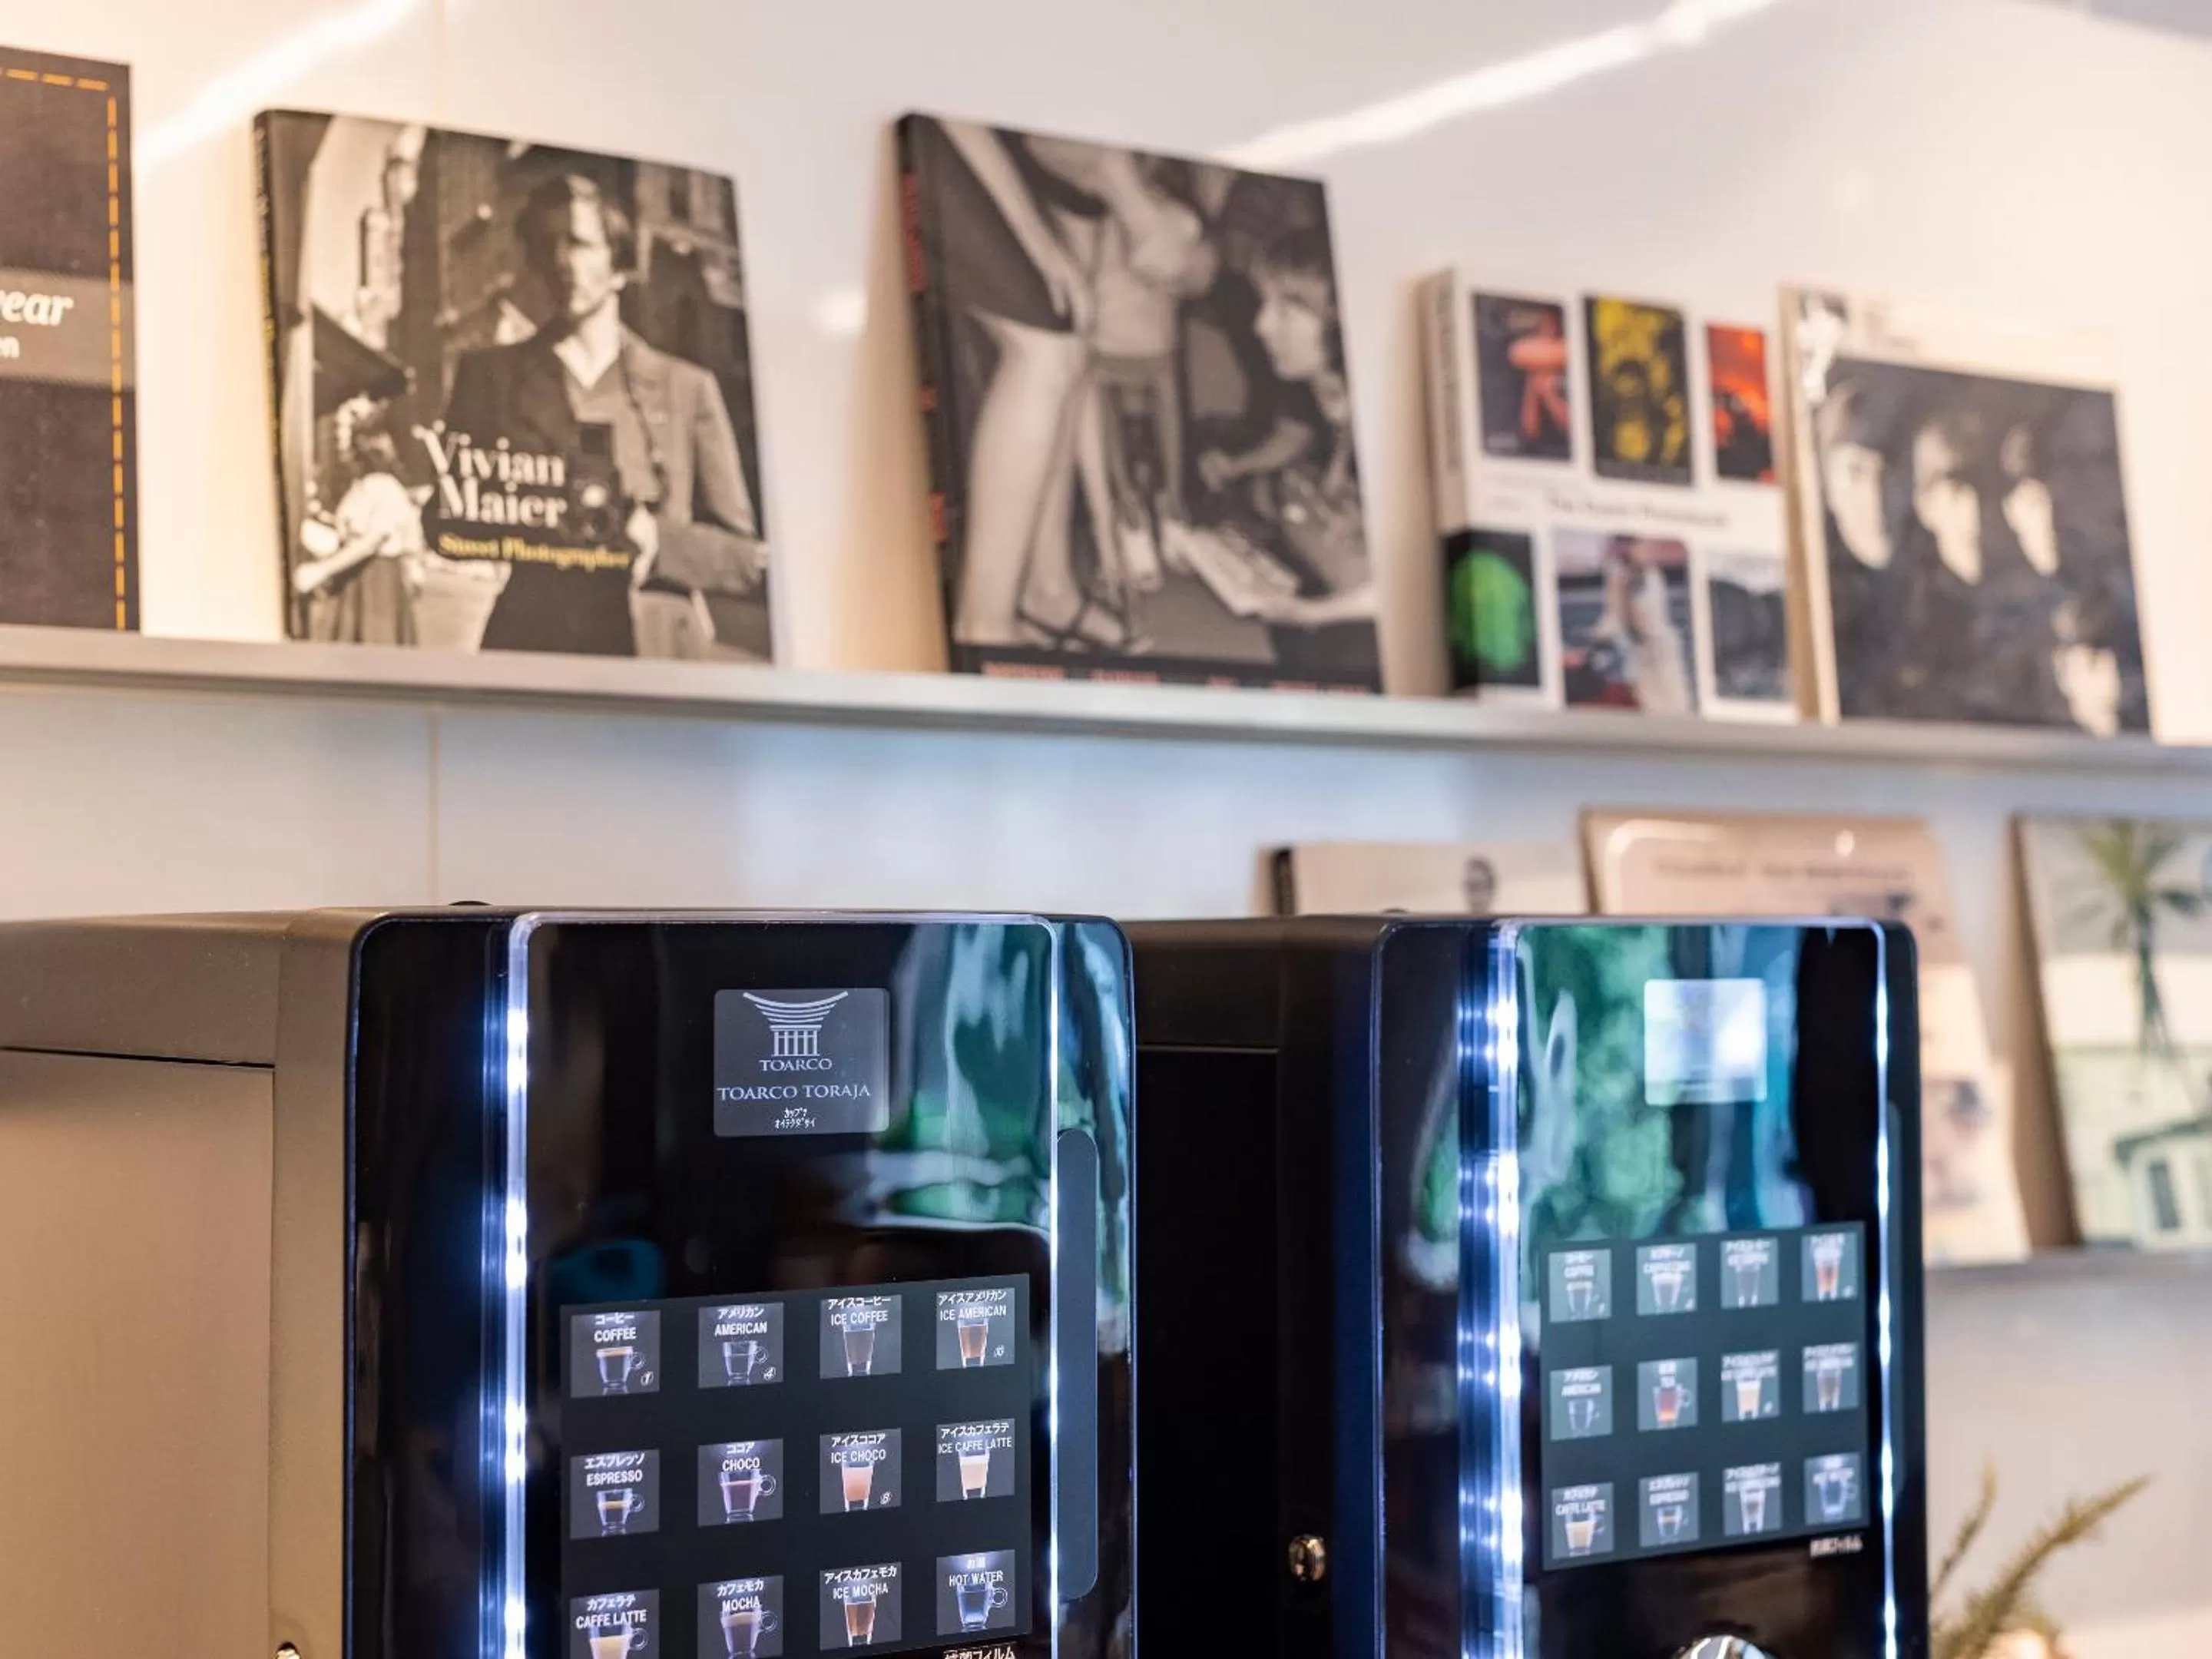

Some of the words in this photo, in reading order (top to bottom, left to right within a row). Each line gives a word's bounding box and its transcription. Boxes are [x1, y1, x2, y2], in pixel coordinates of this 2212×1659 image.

[412, 419, 565, 487] Vivian
[438, 473, 568, 528] Maier
[759, 1058, 833, 1071] TOARCO
[717, 1086, 797, 1101] TOARCO
[803, 1084, 870, 1100] TORAJA
[828, 1296, 892, 1310] アイスコーヒー
[718, 1306, 764, 1319] アメリカン
[831, 1313, 846, 1326] ICE
[850, 1310, 889, 1324] COFFEE
[940, 1309, 955, 1321] ICE
[959, 1305, 1006, 1320] AMERICAN
[594, 1326, 637, 1343] COFFEE
[714, 1321, 767, 1336] AMERICAN
[831, 1433, 886, 1447] アイスココア
[938, 1441, 952, 1454] ICE
[955, 1439, 983, 1452] CAFFE
[985, 1437, 1012, 1449] LATTE
[727, 1442, 755, 1455] ココア
[831, 1451, 846, 1464] ICE
[850, 1449, 886, 1462] CHOCO
[722, 1457, 760, 1472] CHOCO
[586, 1469, 643, 1487] ESPRESSO
[949, 1573, 969, 1588] HOT
[972, 1570, 1003, 1584] WATER
[833, 1586, 849, 1600] ICE
[853, 1582, 888, 1597] MOCHA
[722, 1595, 760, 1613] MOCHA
[576, 1613, 611, 1630] CAFFE
[613, 1609, 647, 1624] LATTE
